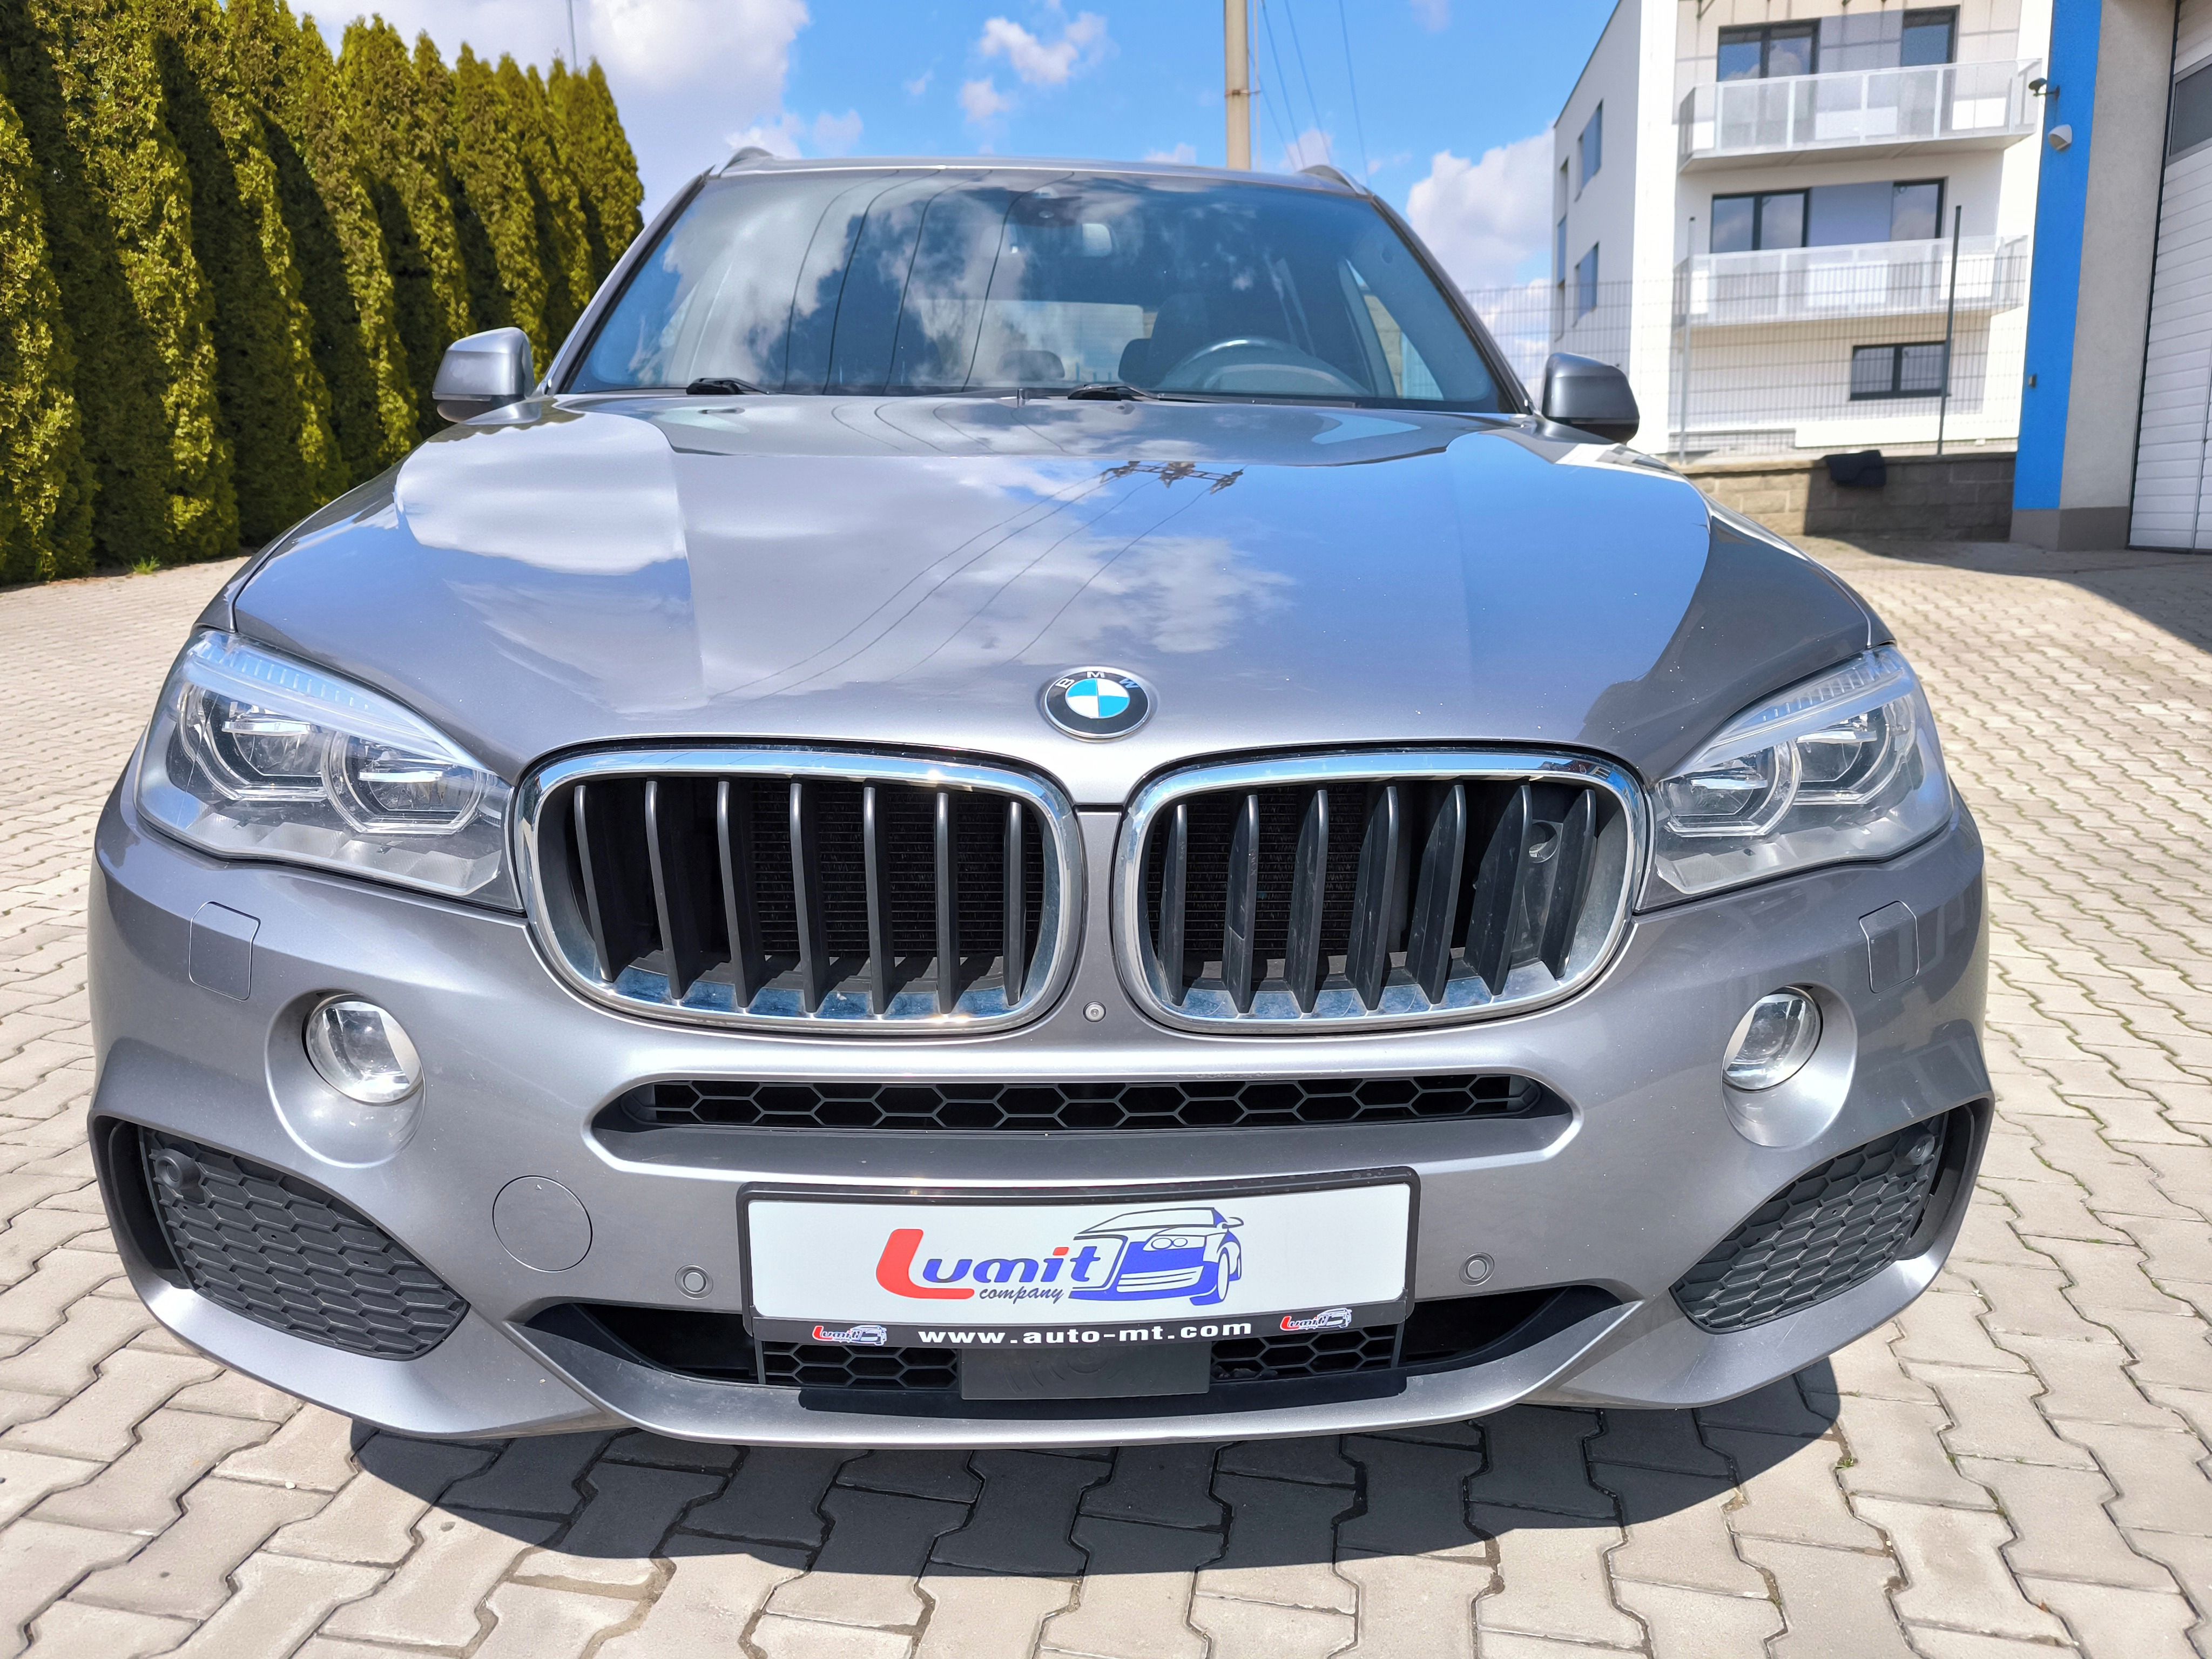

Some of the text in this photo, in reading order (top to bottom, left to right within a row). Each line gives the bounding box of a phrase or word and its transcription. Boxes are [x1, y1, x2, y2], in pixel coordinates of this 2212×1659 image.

[1055, 671, 1139, 689] BMW
[876, 1229, 1101, 1299] Lumit
[979, 1286, 1064, 1304] company
[918, 1322, 1252, 1344] www.auto-mt.com
